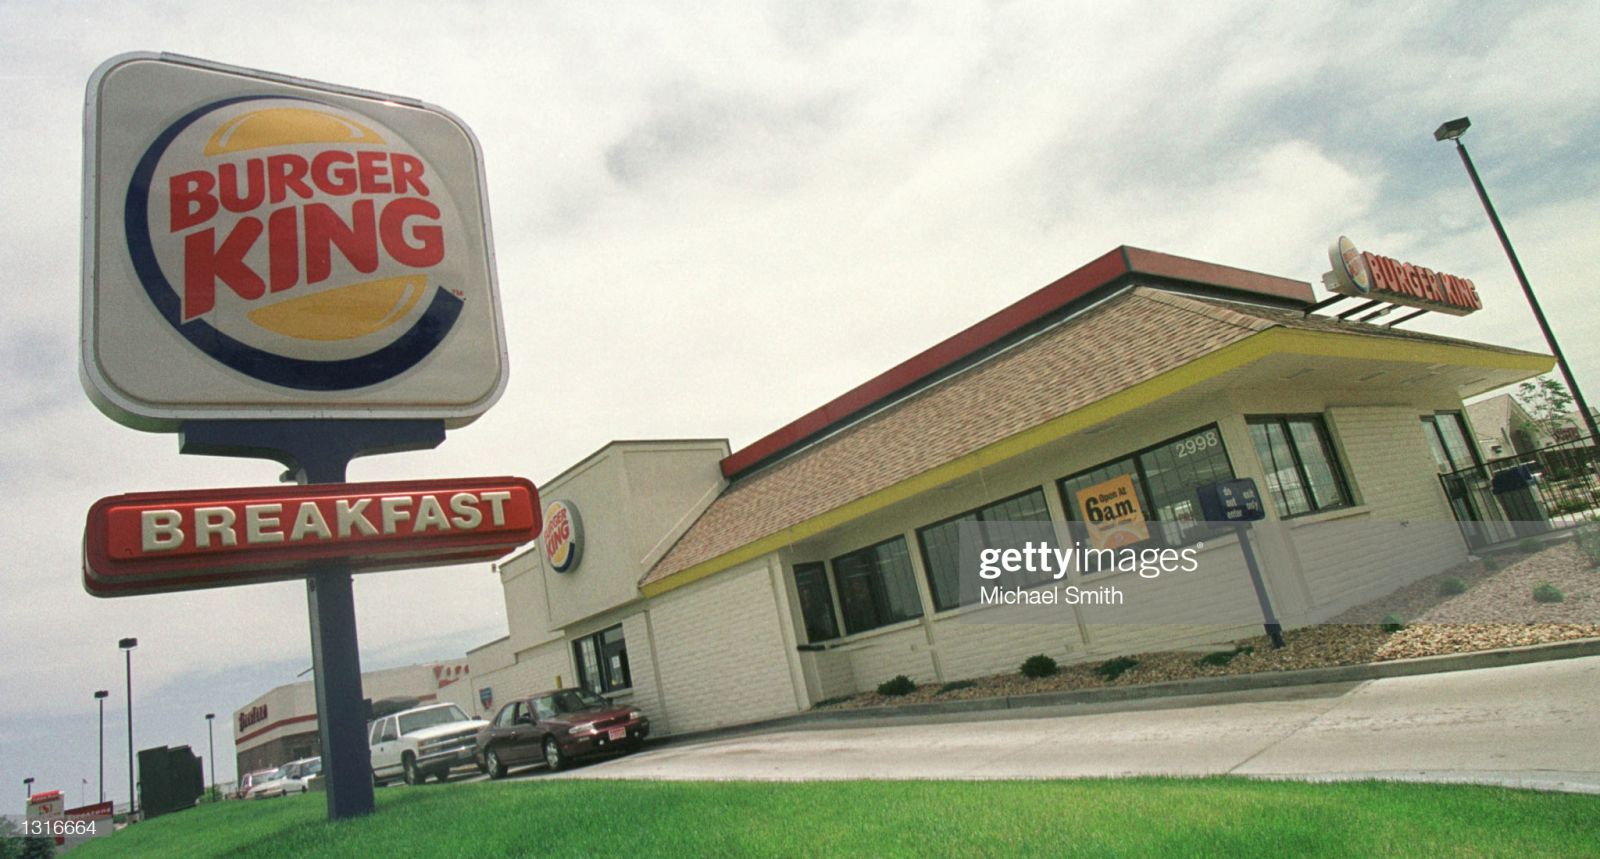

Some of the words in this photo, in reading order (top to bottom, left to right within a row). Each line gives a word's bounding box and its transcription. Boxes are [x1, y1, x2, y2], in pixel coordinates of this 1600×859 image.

[169, 150, 430, 233] BURGER
[181, 197, 445, 322] KING
[1362, 251, 1444, 301] BURGER
[1437, 271, 1483, 310] KING
[1176, 431, 1218, 458] 2998
[141, 491, 511, 552] BREAKFAST
[545, 520, 570, 561] KING
